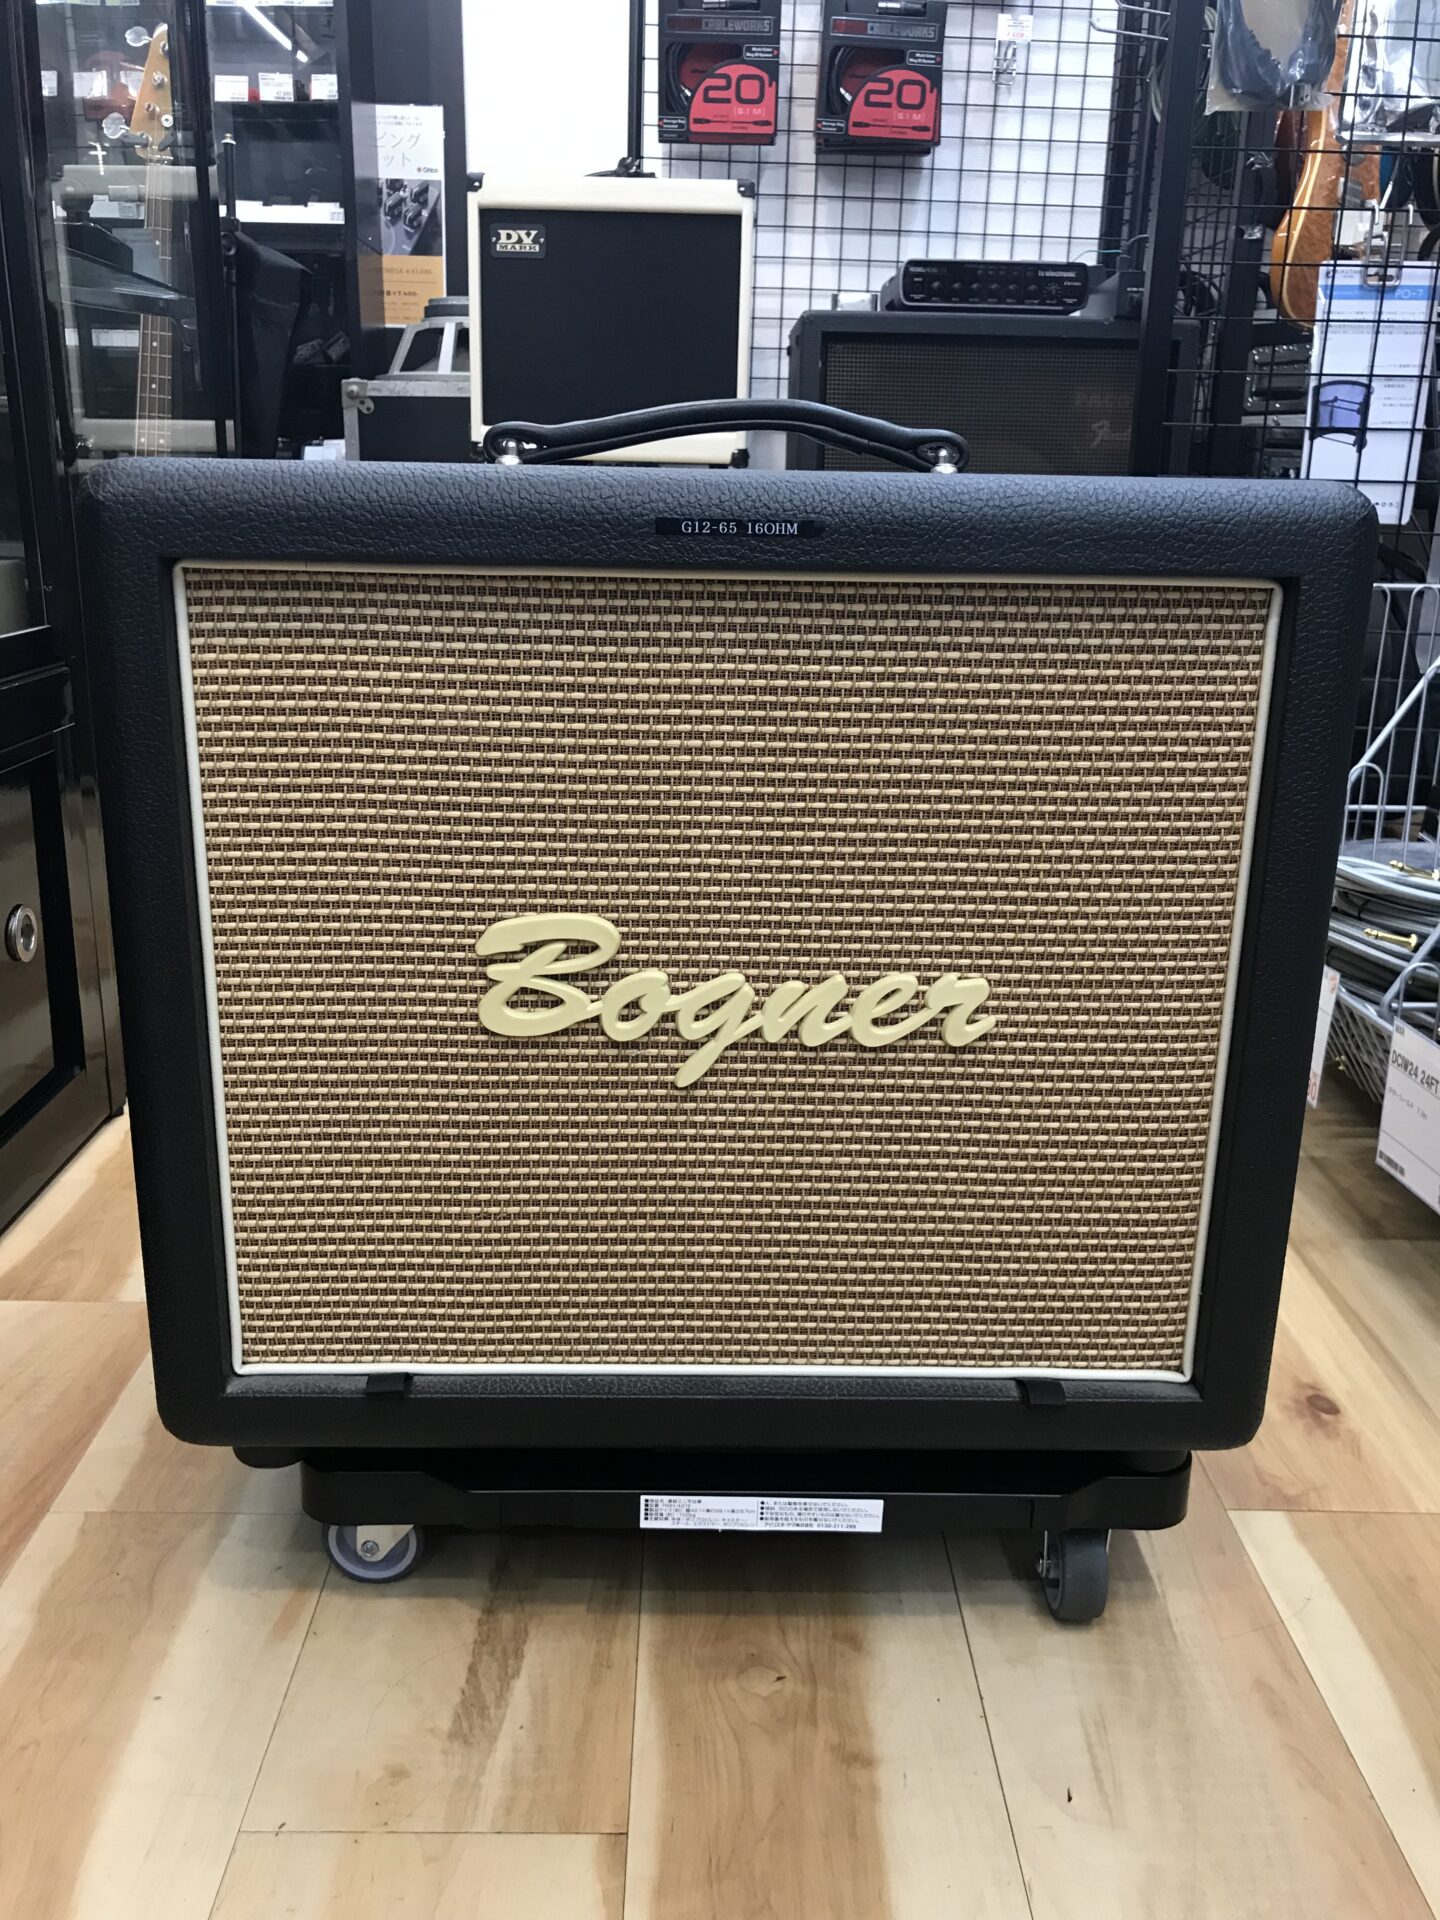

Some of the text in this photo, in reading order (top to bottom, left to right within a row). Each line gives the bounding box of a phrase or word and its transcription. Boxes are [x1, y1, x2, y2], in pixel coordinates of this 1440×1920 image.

[701, 18, 770, 32] CABLEWORKS
[703, 73, 766, 105] 20
[864, 78, 927, 110] 20
[497, 229, 539, 244] DV
[1394, 288, 1424, 299] PO-7
[681, 521, 799, 535] G12-65 16OHM
[475, 912, 997, 1088] Bogner
[1420, 1069, 1440, 1094] 24FT
